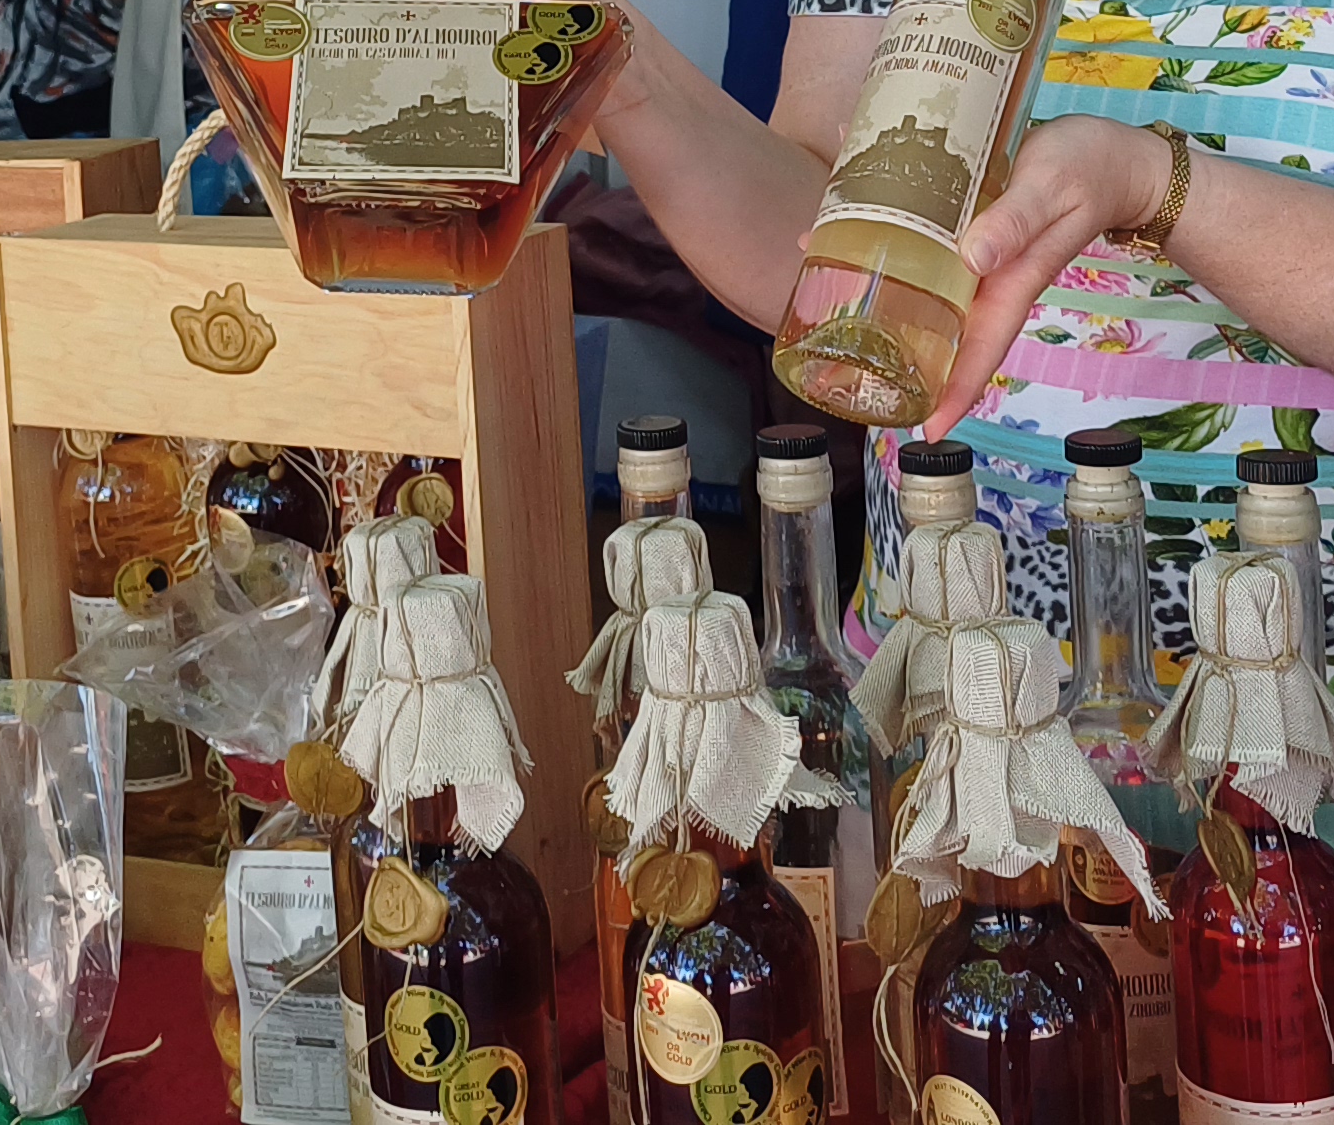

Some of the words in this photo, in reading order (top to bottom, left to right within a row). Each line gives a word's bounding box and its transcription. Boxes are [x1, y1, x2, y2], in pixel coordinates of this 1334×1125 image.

[1007, 10, 1030, 32] LYON
[272, 28, 302, 36] LYON
[312, 27, 390, 45] TESOURO
[921, 58, 969, 83] AMARGA
[393, 1022, 422, 1036] GOLD
[676, 1028, 711, 1047] LYON
[666, 1041, 681, 1054] OR
[666, 1051, 693, 1067] GOLD
[453, 1090, 485, 1103] GOLD
[703, 1083, 738, 1095] GOLD
[782, 1093, 808, 1115] GOLD
